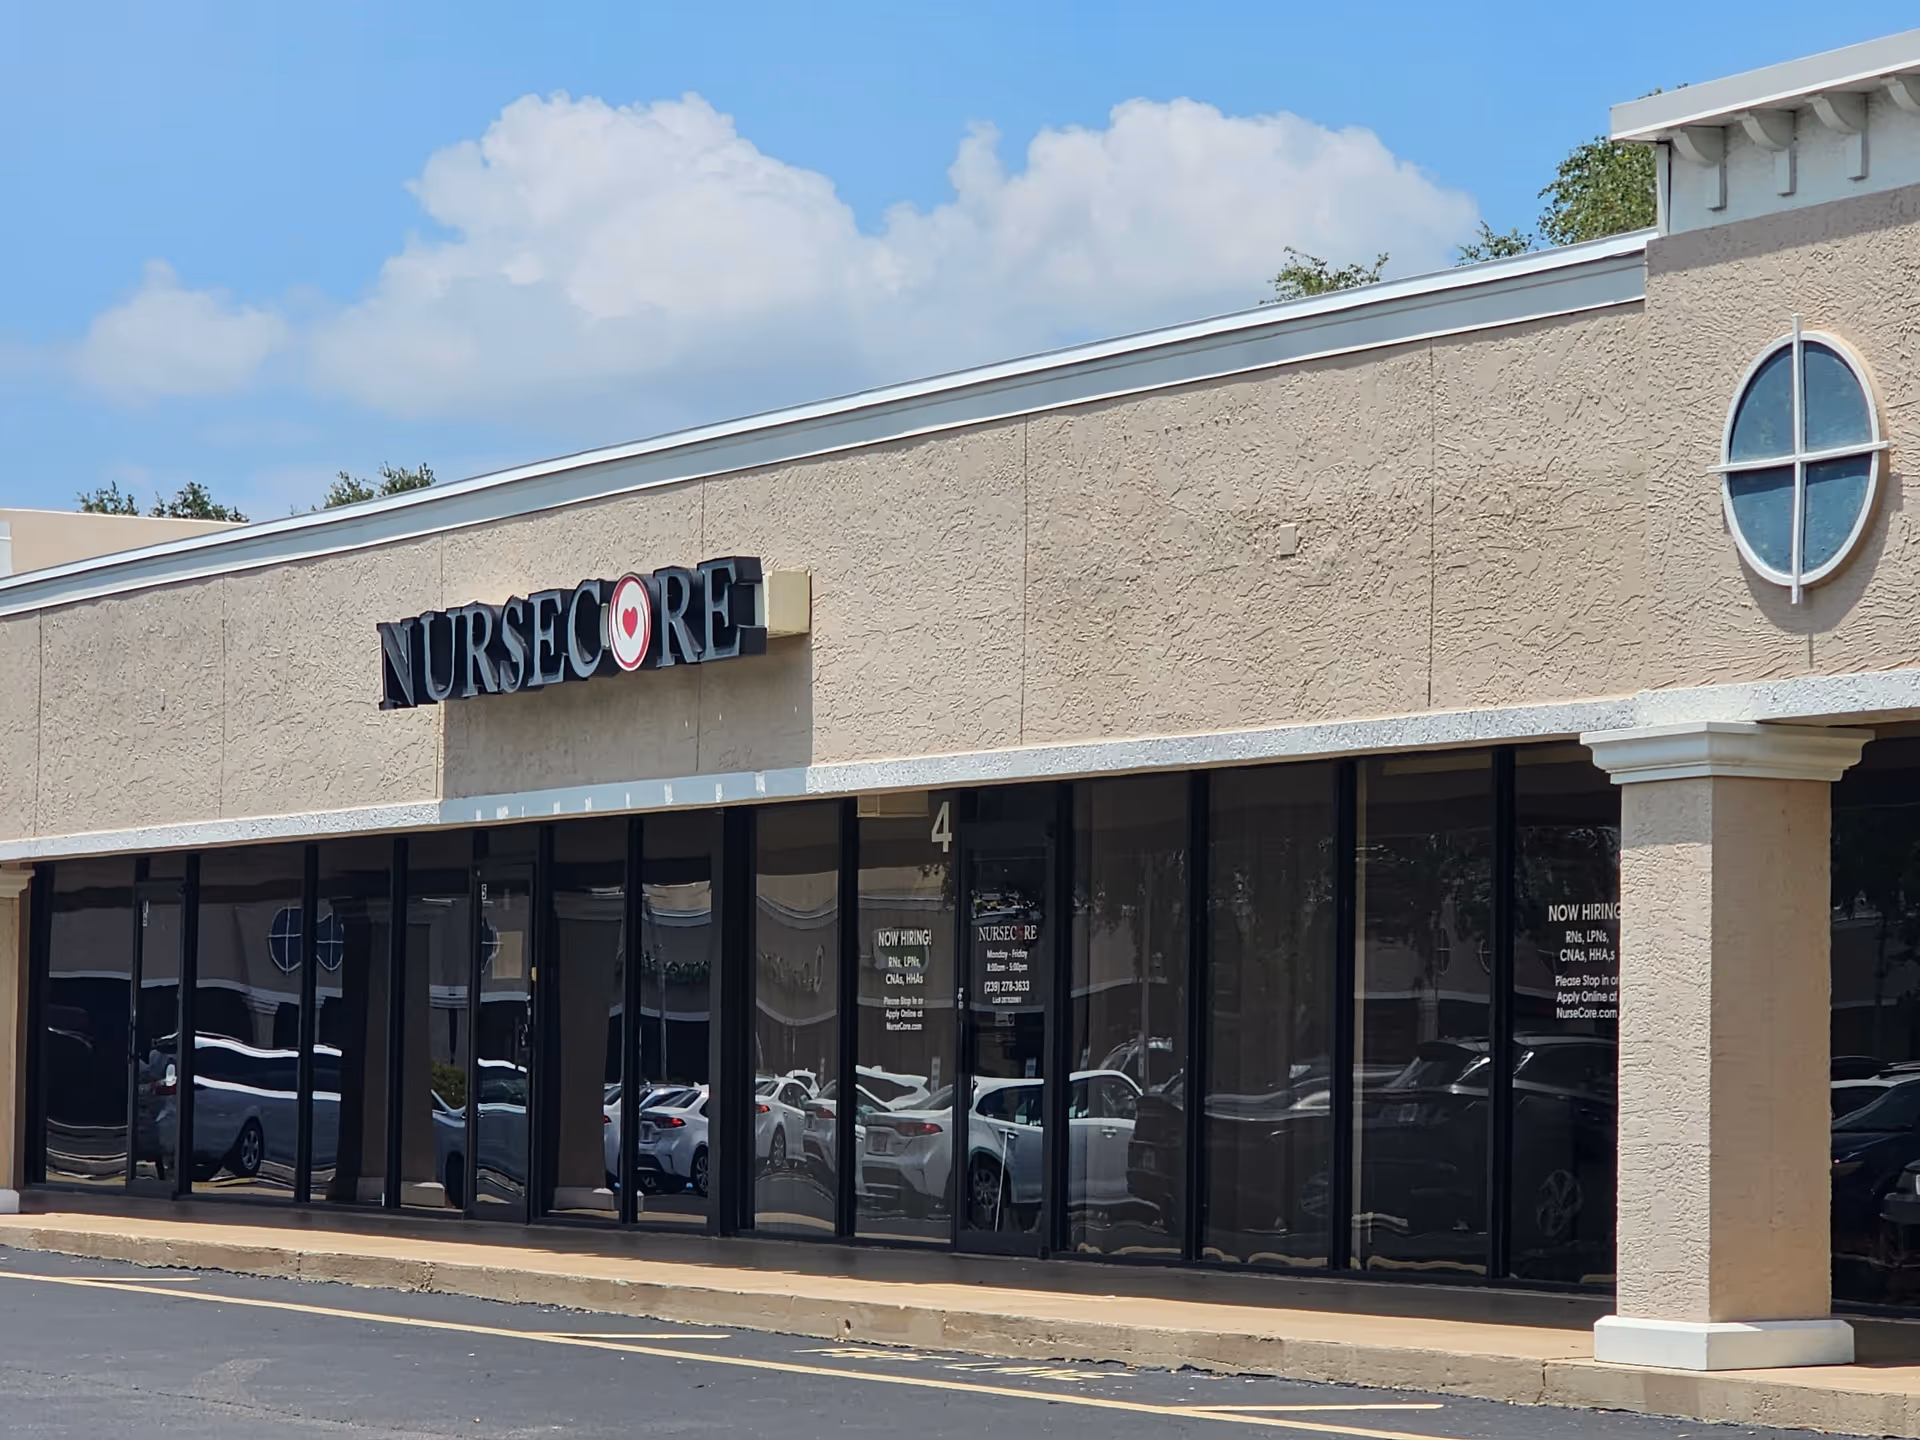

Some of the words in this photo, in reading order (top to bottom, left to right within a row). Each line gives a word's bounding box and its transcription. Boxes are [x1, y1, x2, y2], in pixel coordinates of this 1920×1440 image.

[377, 556, 766, 711] NURSECORE
[931, 801, 952, 853] 4
[1548, 904, 1579, 922] NOW
[878, 931, 899, 947] NOW
[900, 929, 932, 946] HIRING!
[1565, 930, 1585, 944] RNs,
[1586, 930, 1610, 944] LPNs,
[986, 949, 1008, 960] Monday
[1011, 948, 1028, 960] Friday
[1560, 948, 1587, 963] CNAs,
[888, 956, 903, 968] RNs,
[904, 955, 921, 968] LPNs,
[885, 973, 905, 986] CNAs,
[906, 972, 924, 984] HHAs
[1555, 975, 1581, 987] Please
[1582, 974, 1600, 988] Stop
[1601, 974, 1609, 985] in
[984, 981, 1000, 994] (239)
[1001, 980, 1030, 992] 278-3633
[883, 996, 899, 1005] Please
[900, 995, 911, 1006] Stop
[912, 996, 917, 1005] in
[918, 997, 924, 1005] or
[1556, 991, 1580, 1004] Apply
[1581, 991, 1608, 1002] Online
[1608, 991, 1618, 1002] at
[885, 1009, 900, 1019] Apply
[900, 1009, 917, 1018] Online
[917, 1009, 923, 1018] at
[1556, 1006, 1617, 1019] NurseCore.com
[886, 1022, 922, 1031] NurseCore.com
